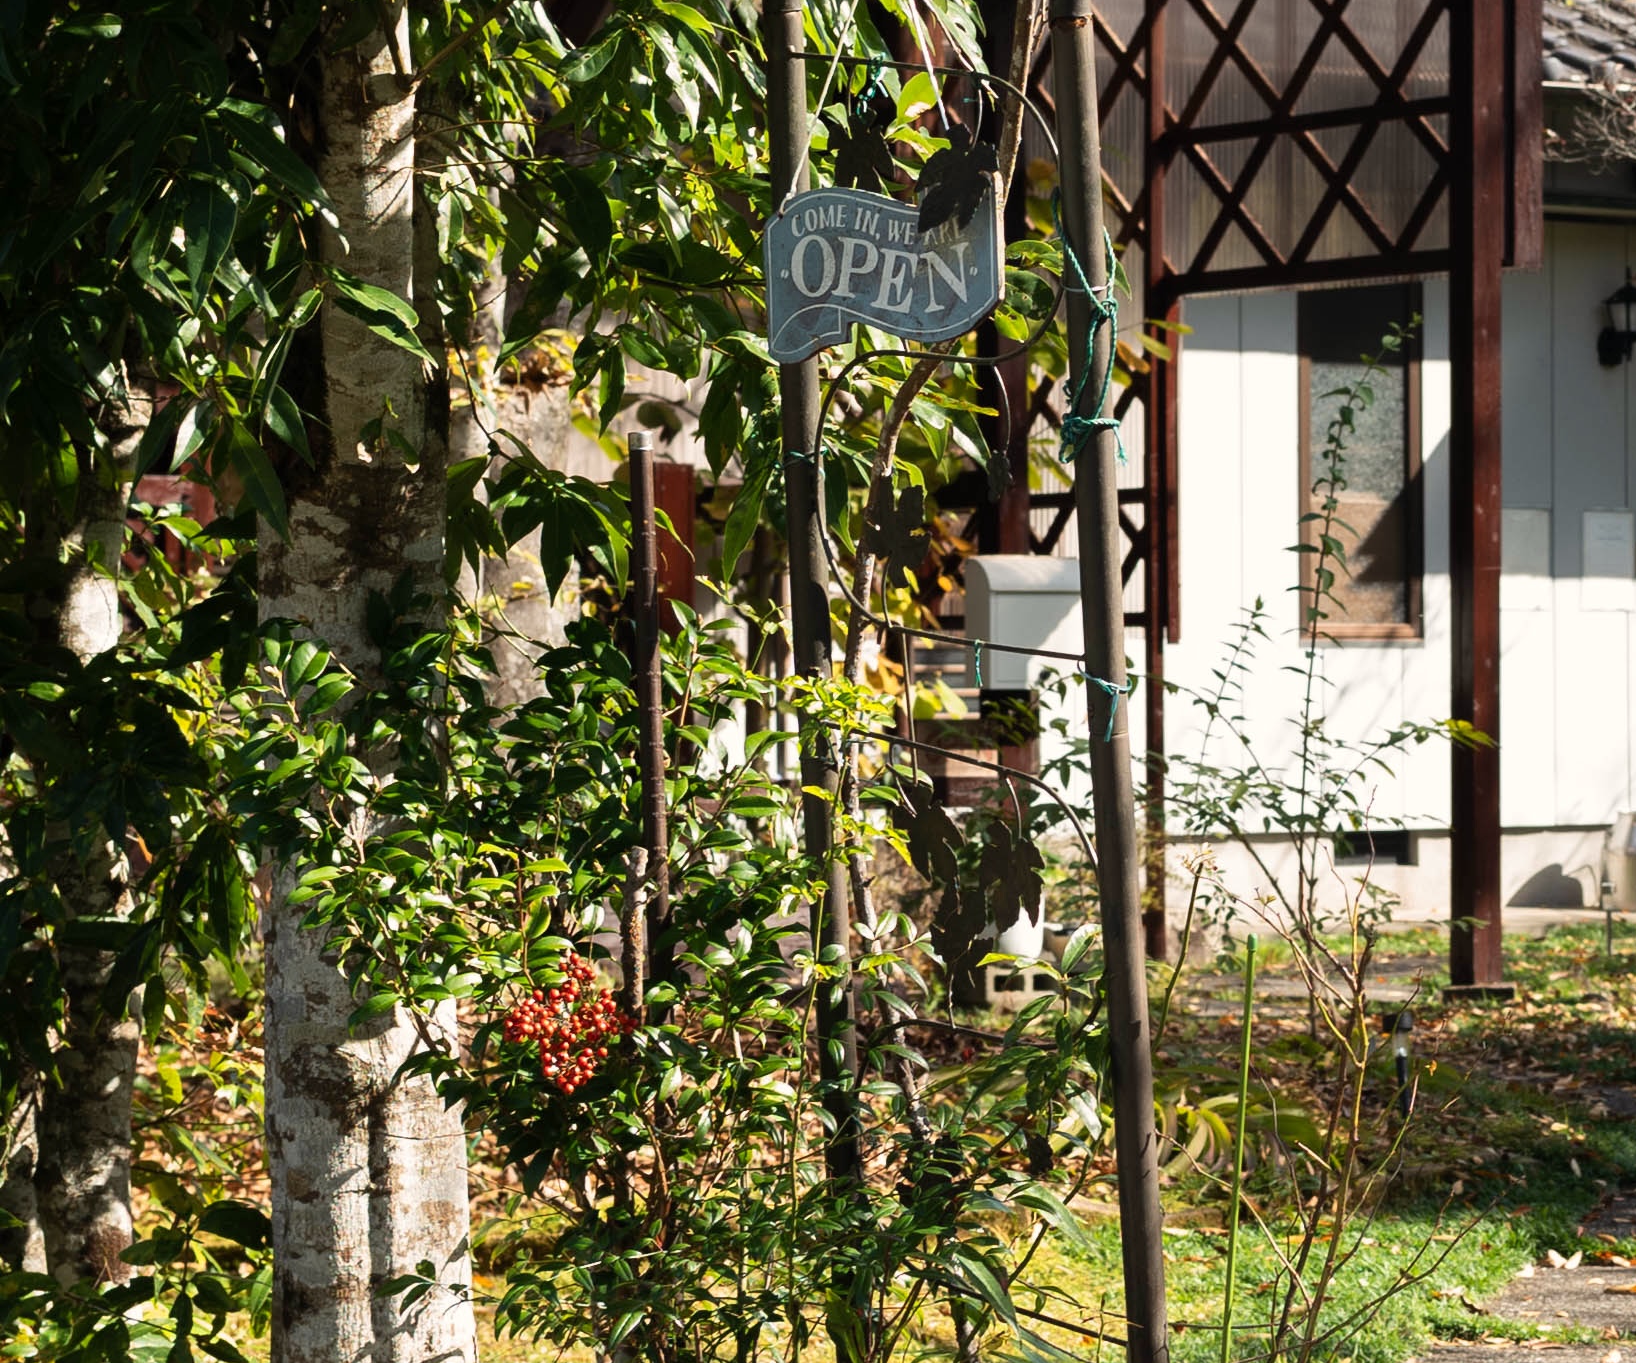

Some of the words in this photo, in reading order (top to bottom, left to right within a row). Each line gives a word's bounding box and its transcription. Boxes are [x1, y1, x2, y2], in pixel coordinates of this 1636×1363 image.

[791, 204, 848, 237] COME
[854, 207, 881, 241] IN,
[888, 219, 916, 245] WE
[791, 235, 969, 313] OPEN
